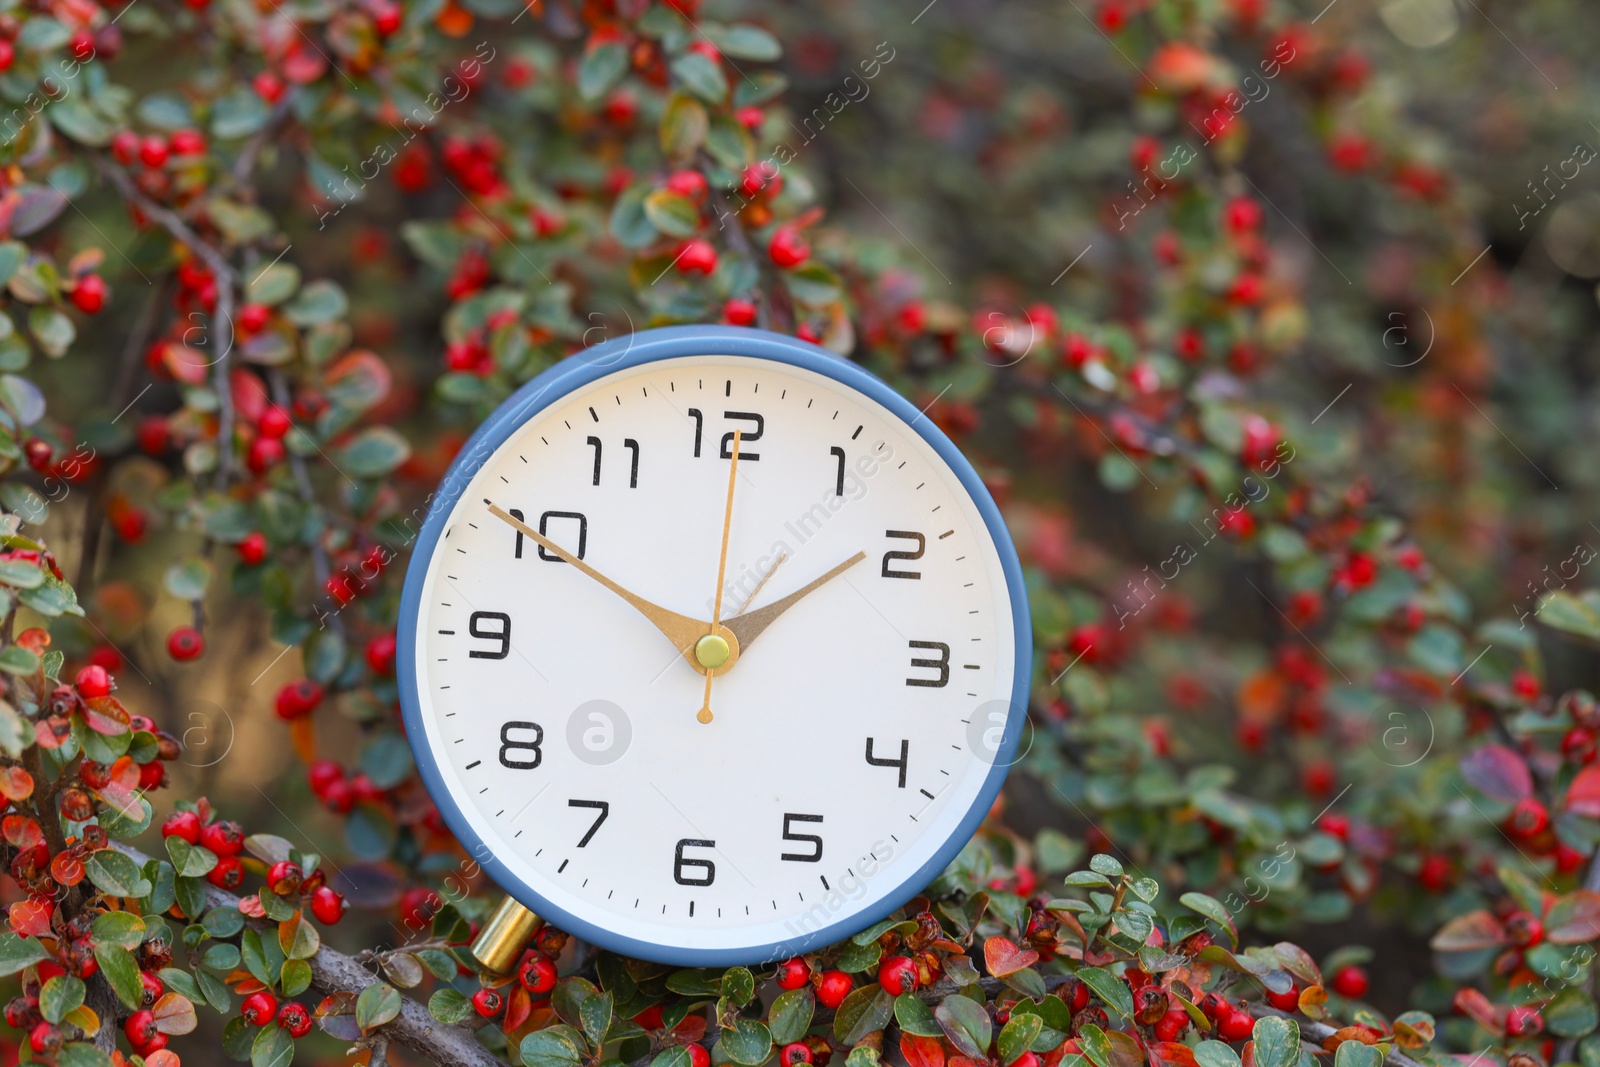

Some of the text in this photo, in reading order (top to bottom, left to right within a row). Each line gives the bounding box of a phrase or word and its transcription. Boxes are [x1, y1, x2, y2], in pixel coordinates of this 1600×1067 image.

[689, 409, 764, 461] 12
[587, 436, 639, 488] 11
[831, 447, 845, 496] 1
[510, 509, 587, 562] 10
[882, 530, 925, 579] 2
[470, 611, 511, 659] 9
[906, 641, 949, 687] 3
[499, 722, 543, 769] 8
[866, 738, 908, 787] 4
[569, 800, 608, 847] 7
[782, 813, 823, 862] 5
[674, 839, 715, 886] 6
